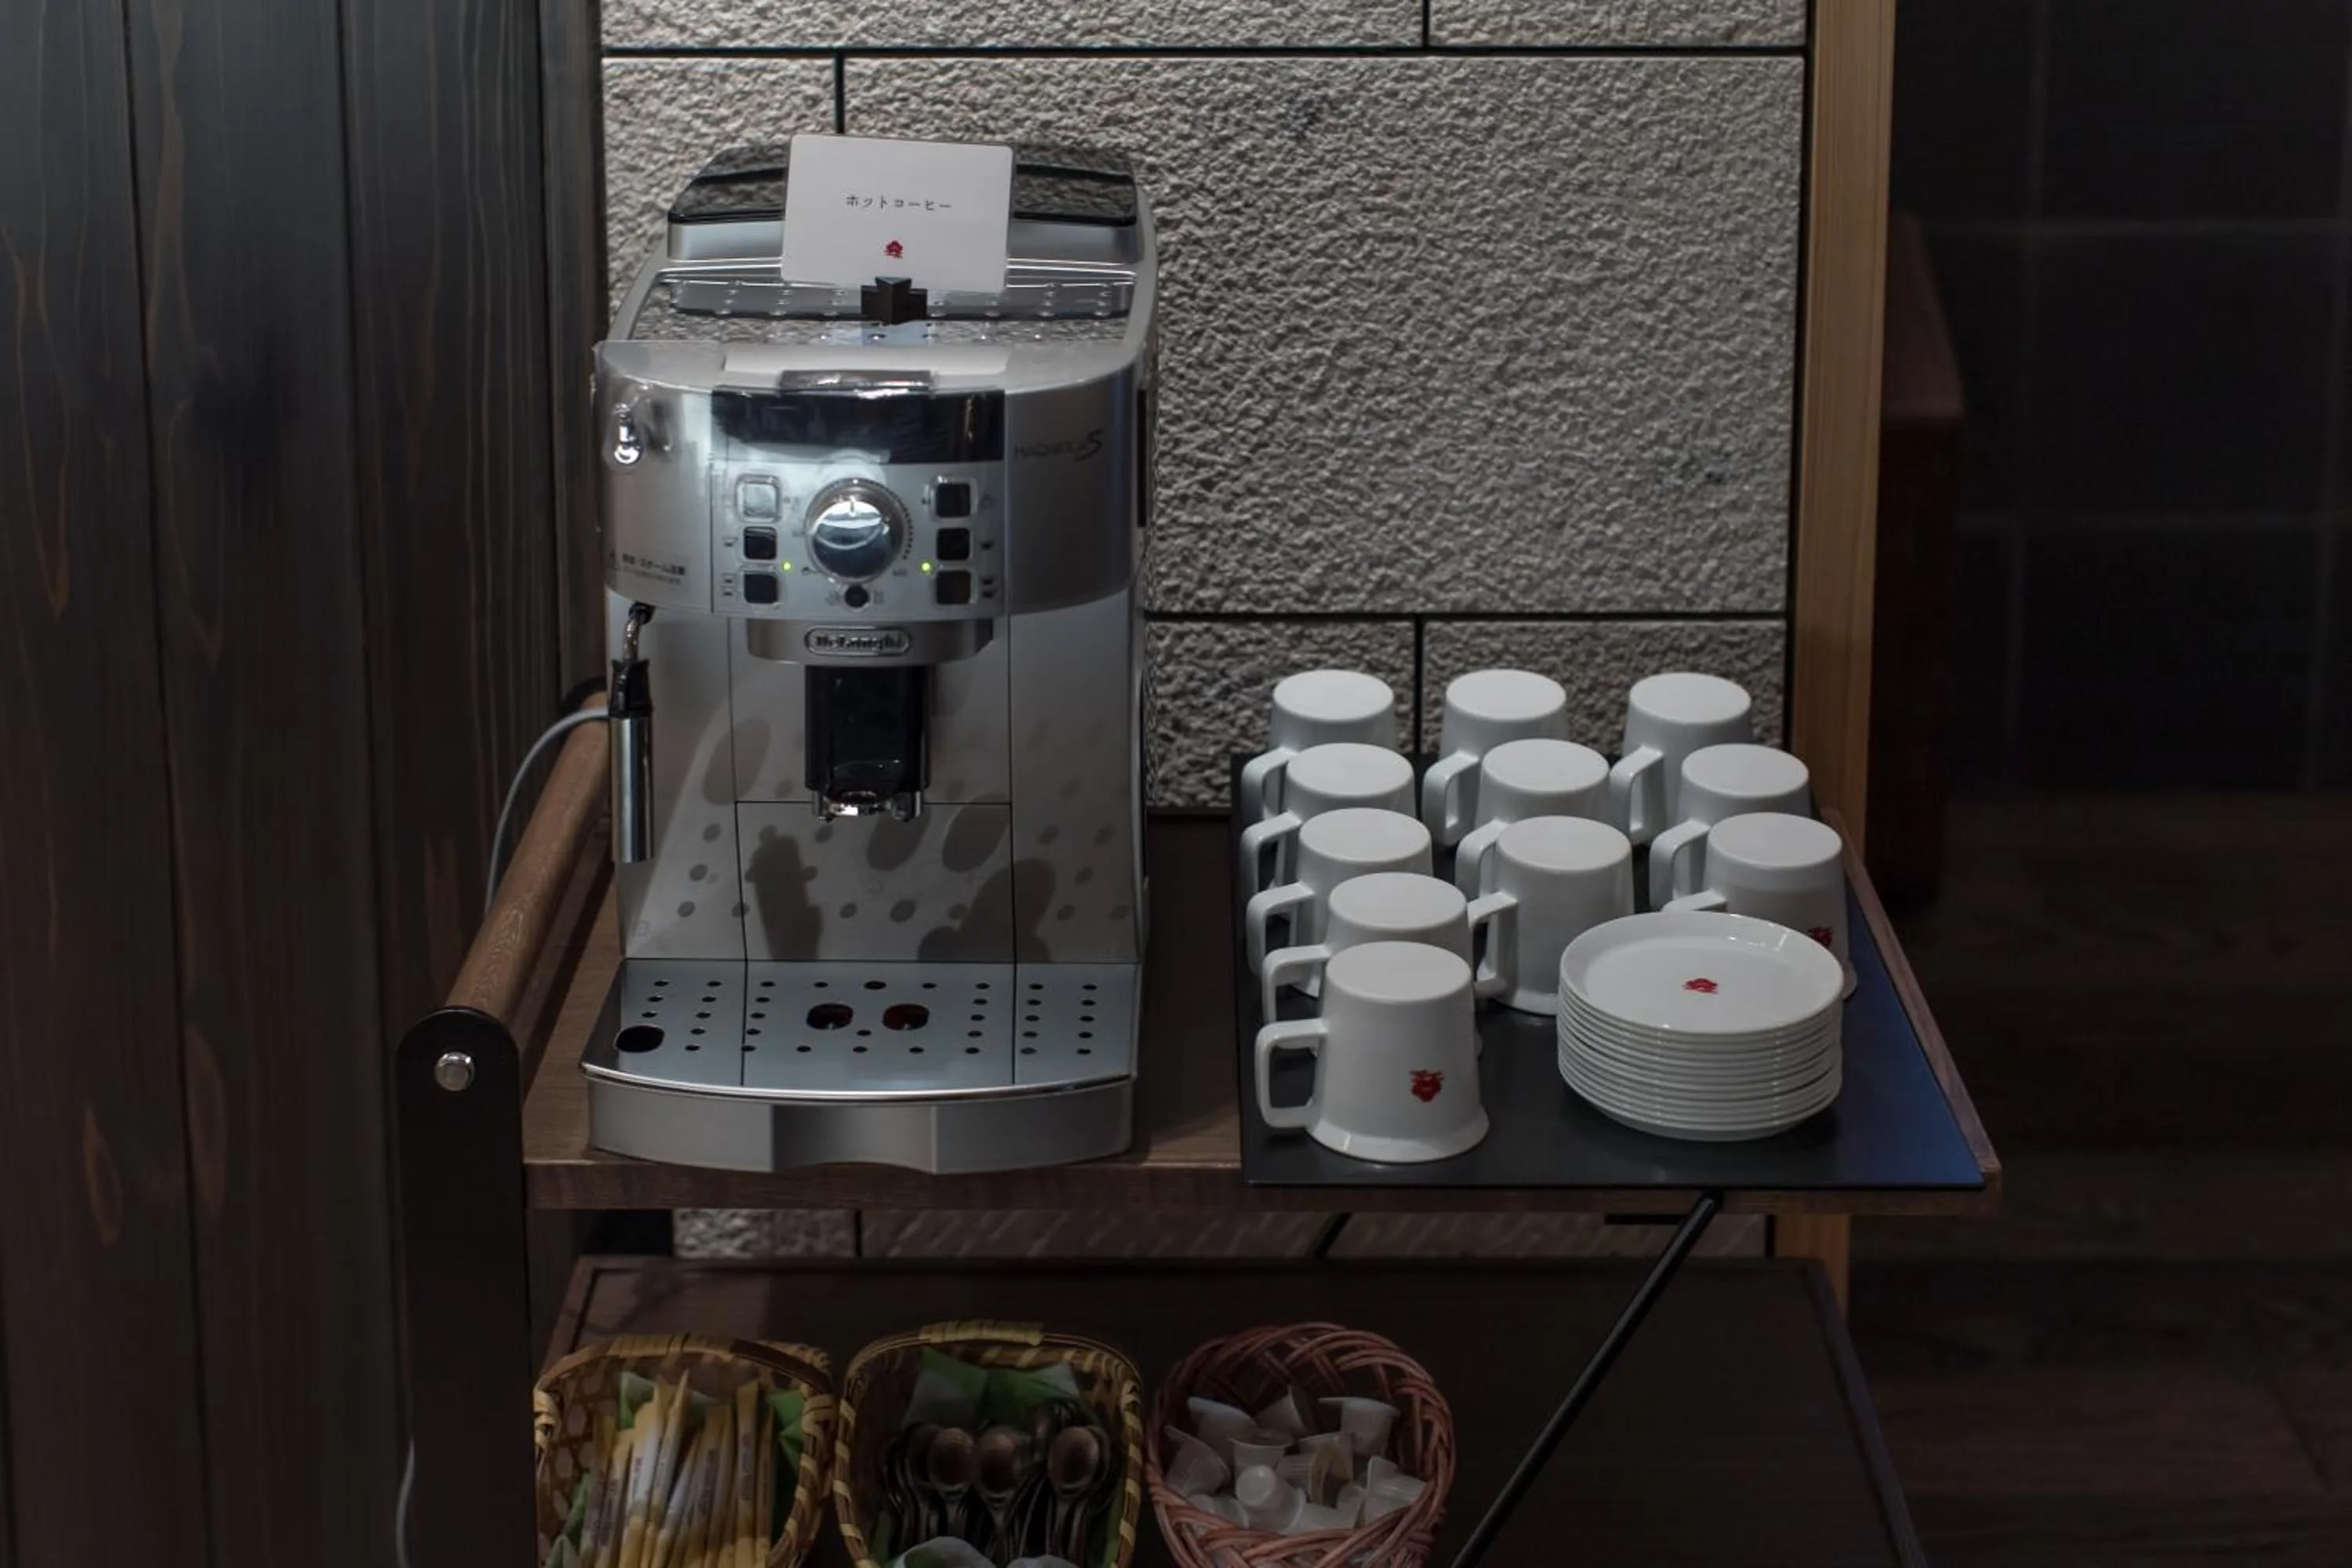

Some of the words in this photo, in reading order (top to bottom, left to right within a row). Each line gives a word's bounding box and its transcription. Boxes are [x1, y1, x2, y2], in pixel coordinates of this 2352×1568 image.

[846, 194, 953, 211] ホットコーヒー
